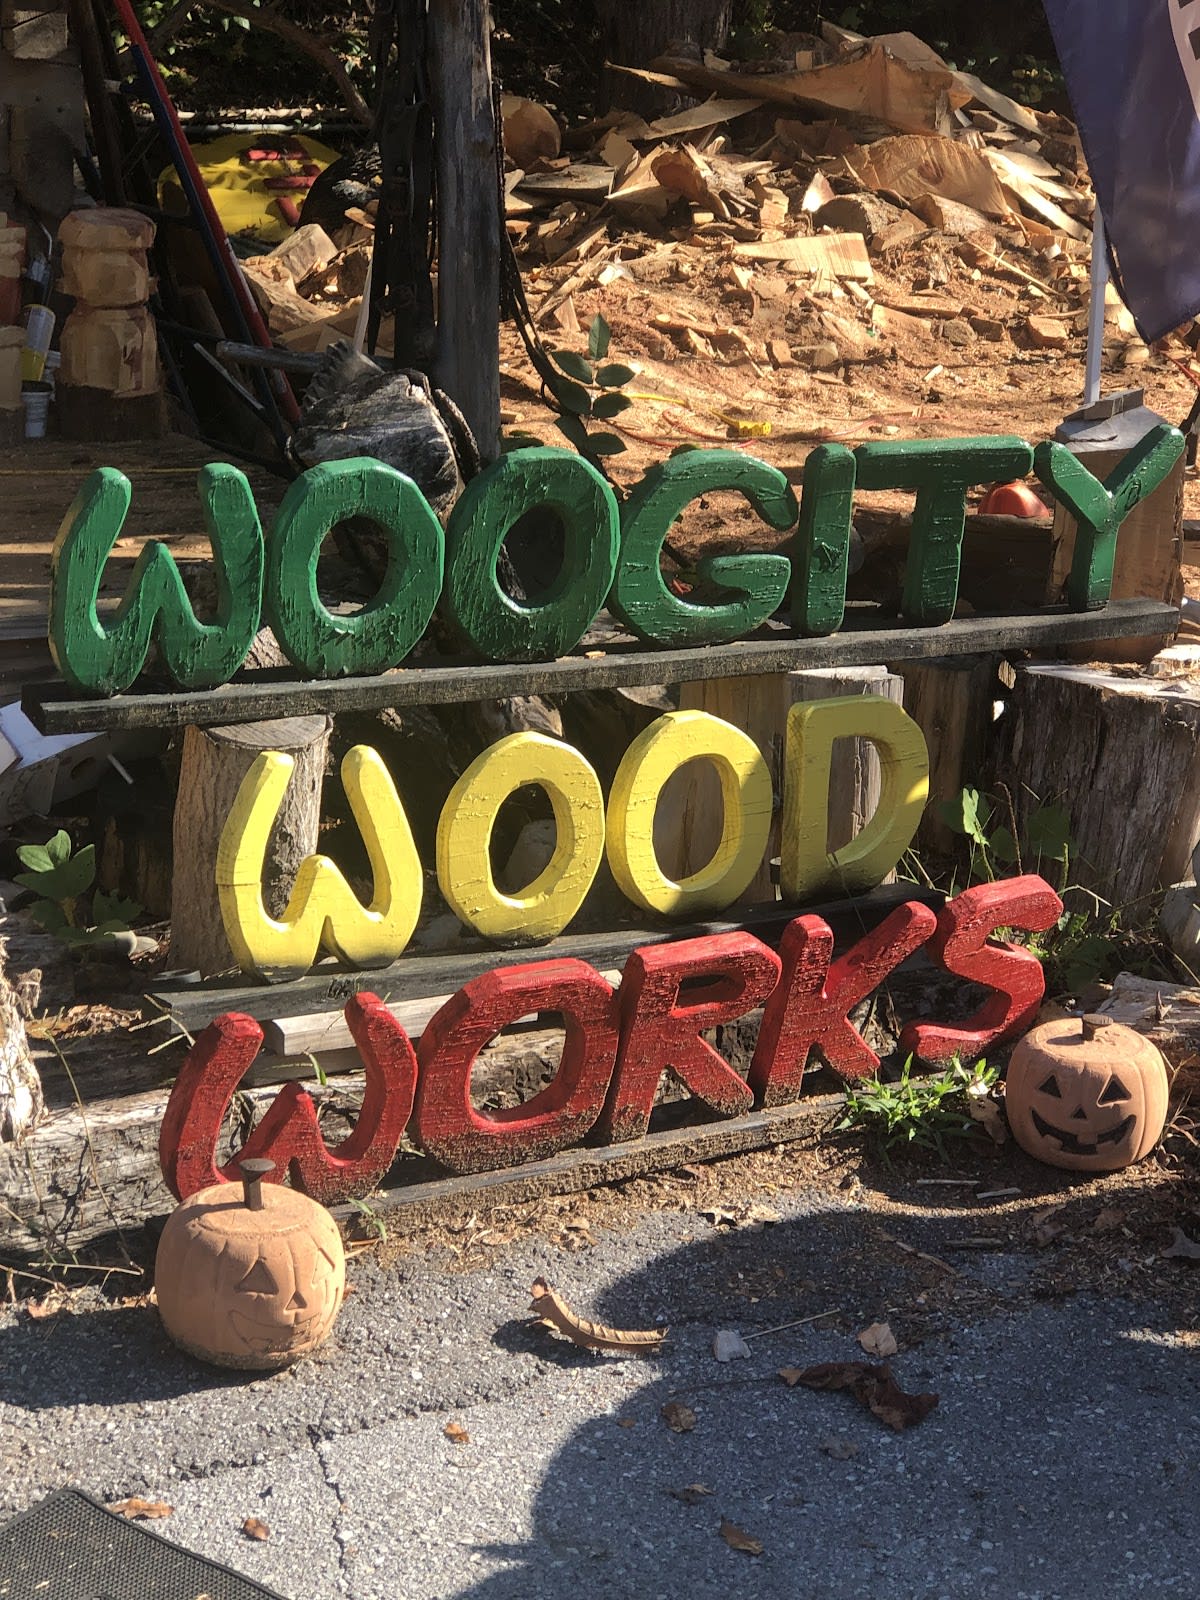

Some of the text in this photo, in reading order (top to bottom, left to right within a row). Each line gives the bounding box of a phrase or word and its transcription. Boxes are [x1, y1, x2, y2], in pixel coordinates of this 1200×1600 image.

[50, 424, 1185, 695] WOOGITY
[216, 694, 930, 983] WOOD
[160, 874, 1064, 1201] WORKS
